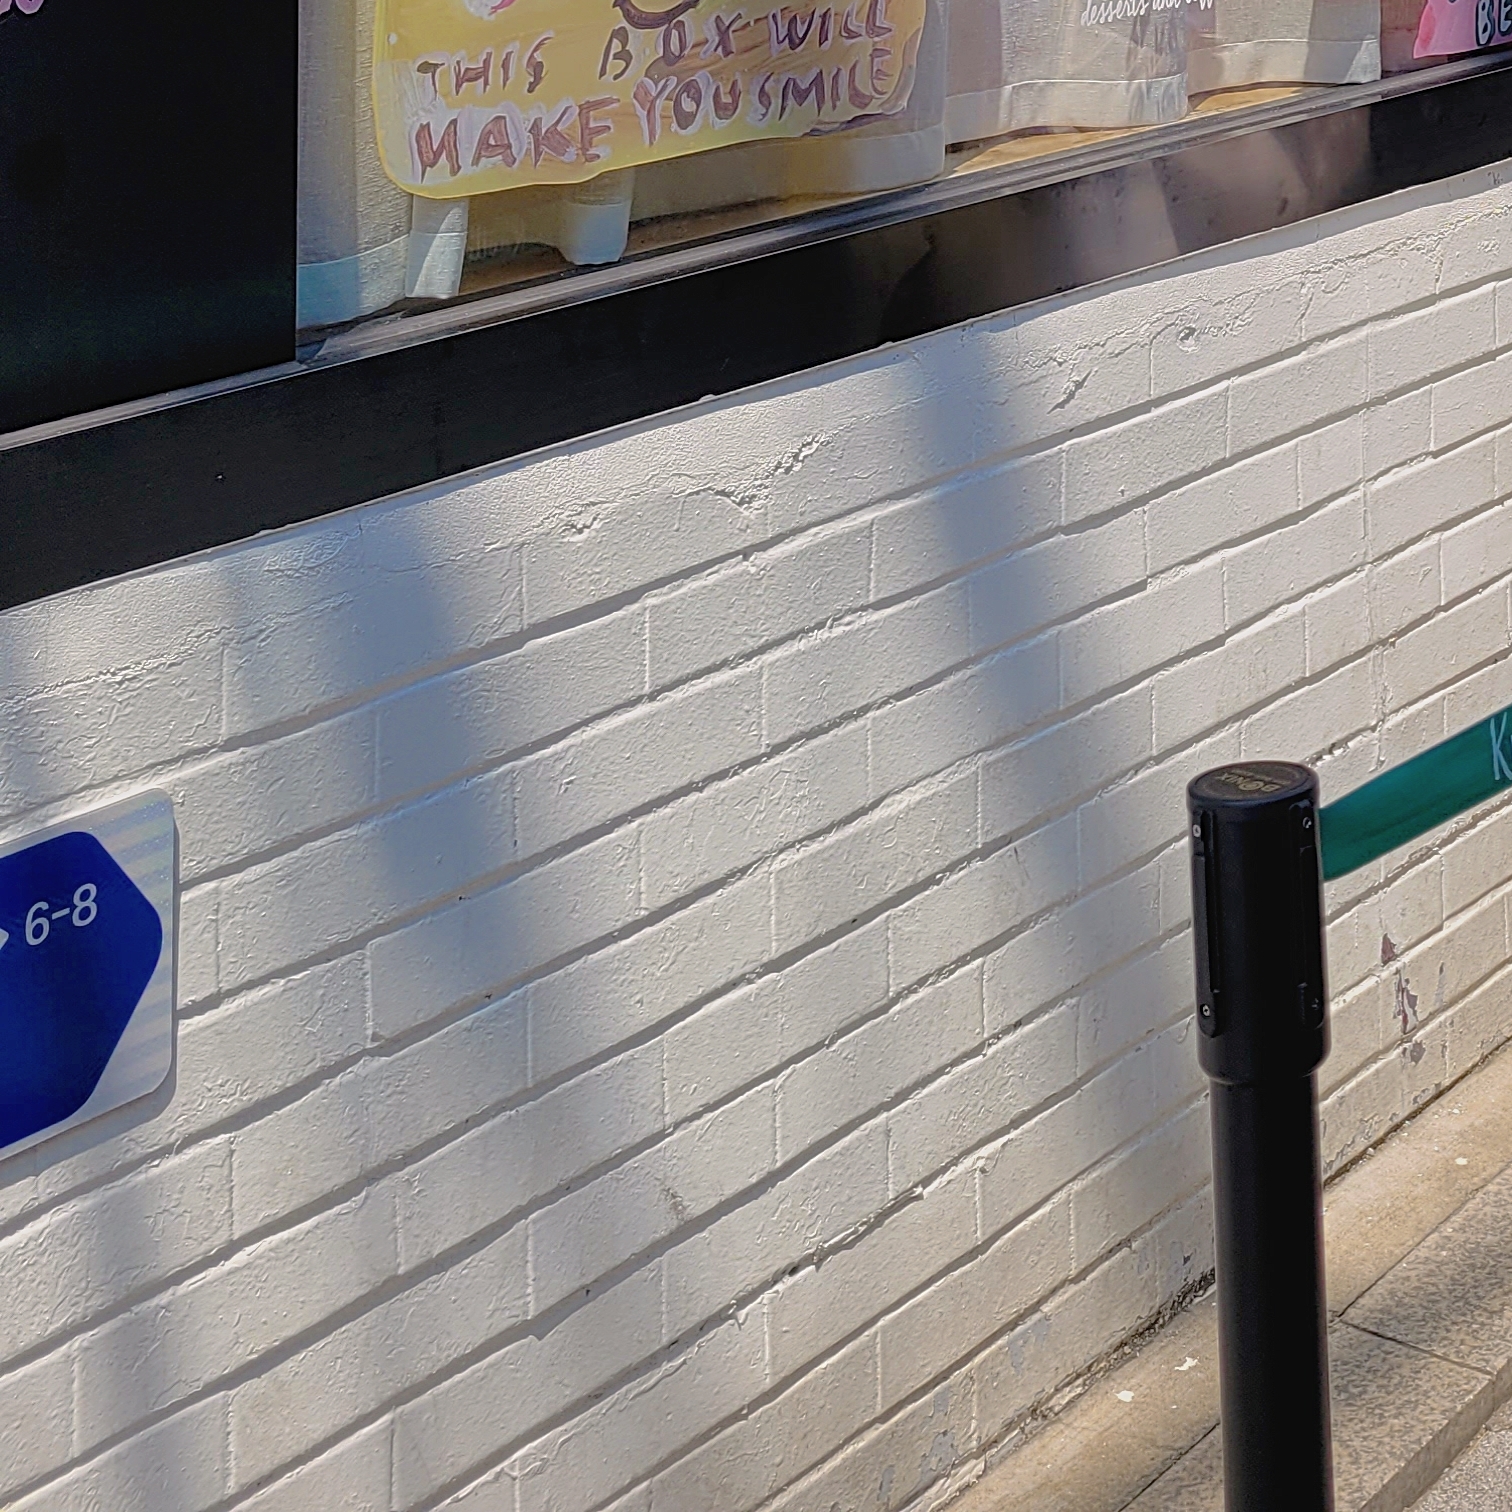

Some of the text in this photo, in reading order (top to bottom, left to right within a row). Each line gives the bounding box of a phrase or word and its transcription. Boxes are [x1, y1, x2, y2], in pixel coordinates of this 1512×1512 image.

[415, 30, 555, 99] THIS
[598, 10, 745, 82] BOX
[413, 46, 898, 185] MAKE YOU SMILE
[24, 883, 98, 947] 6-8
